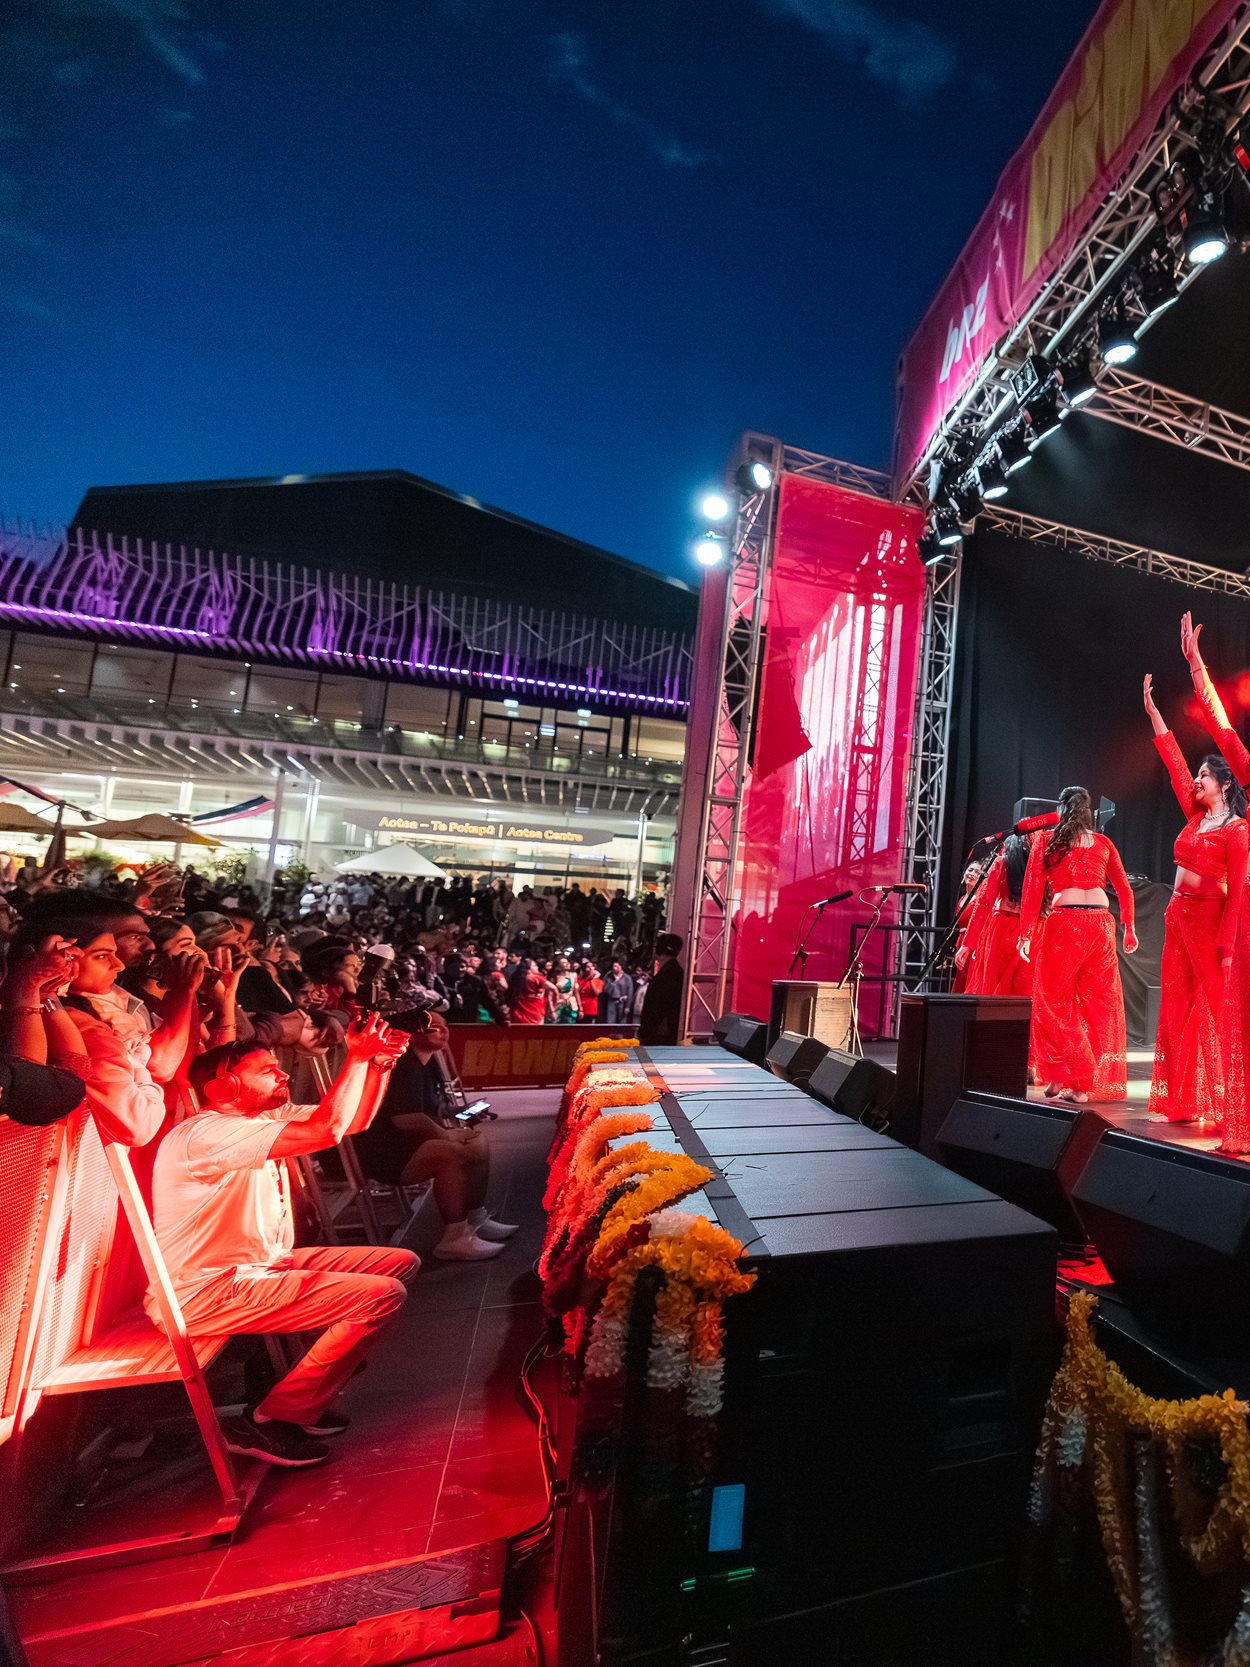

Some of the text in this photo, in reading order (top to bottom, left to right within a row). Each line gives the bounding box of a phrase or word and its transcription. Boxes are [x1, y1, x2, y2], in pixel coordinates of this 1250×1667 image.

[378, 816, 418, 830] Aotea
[506, 826, 543, 839] Aotea
[543, 829, 584, 842] Centre
